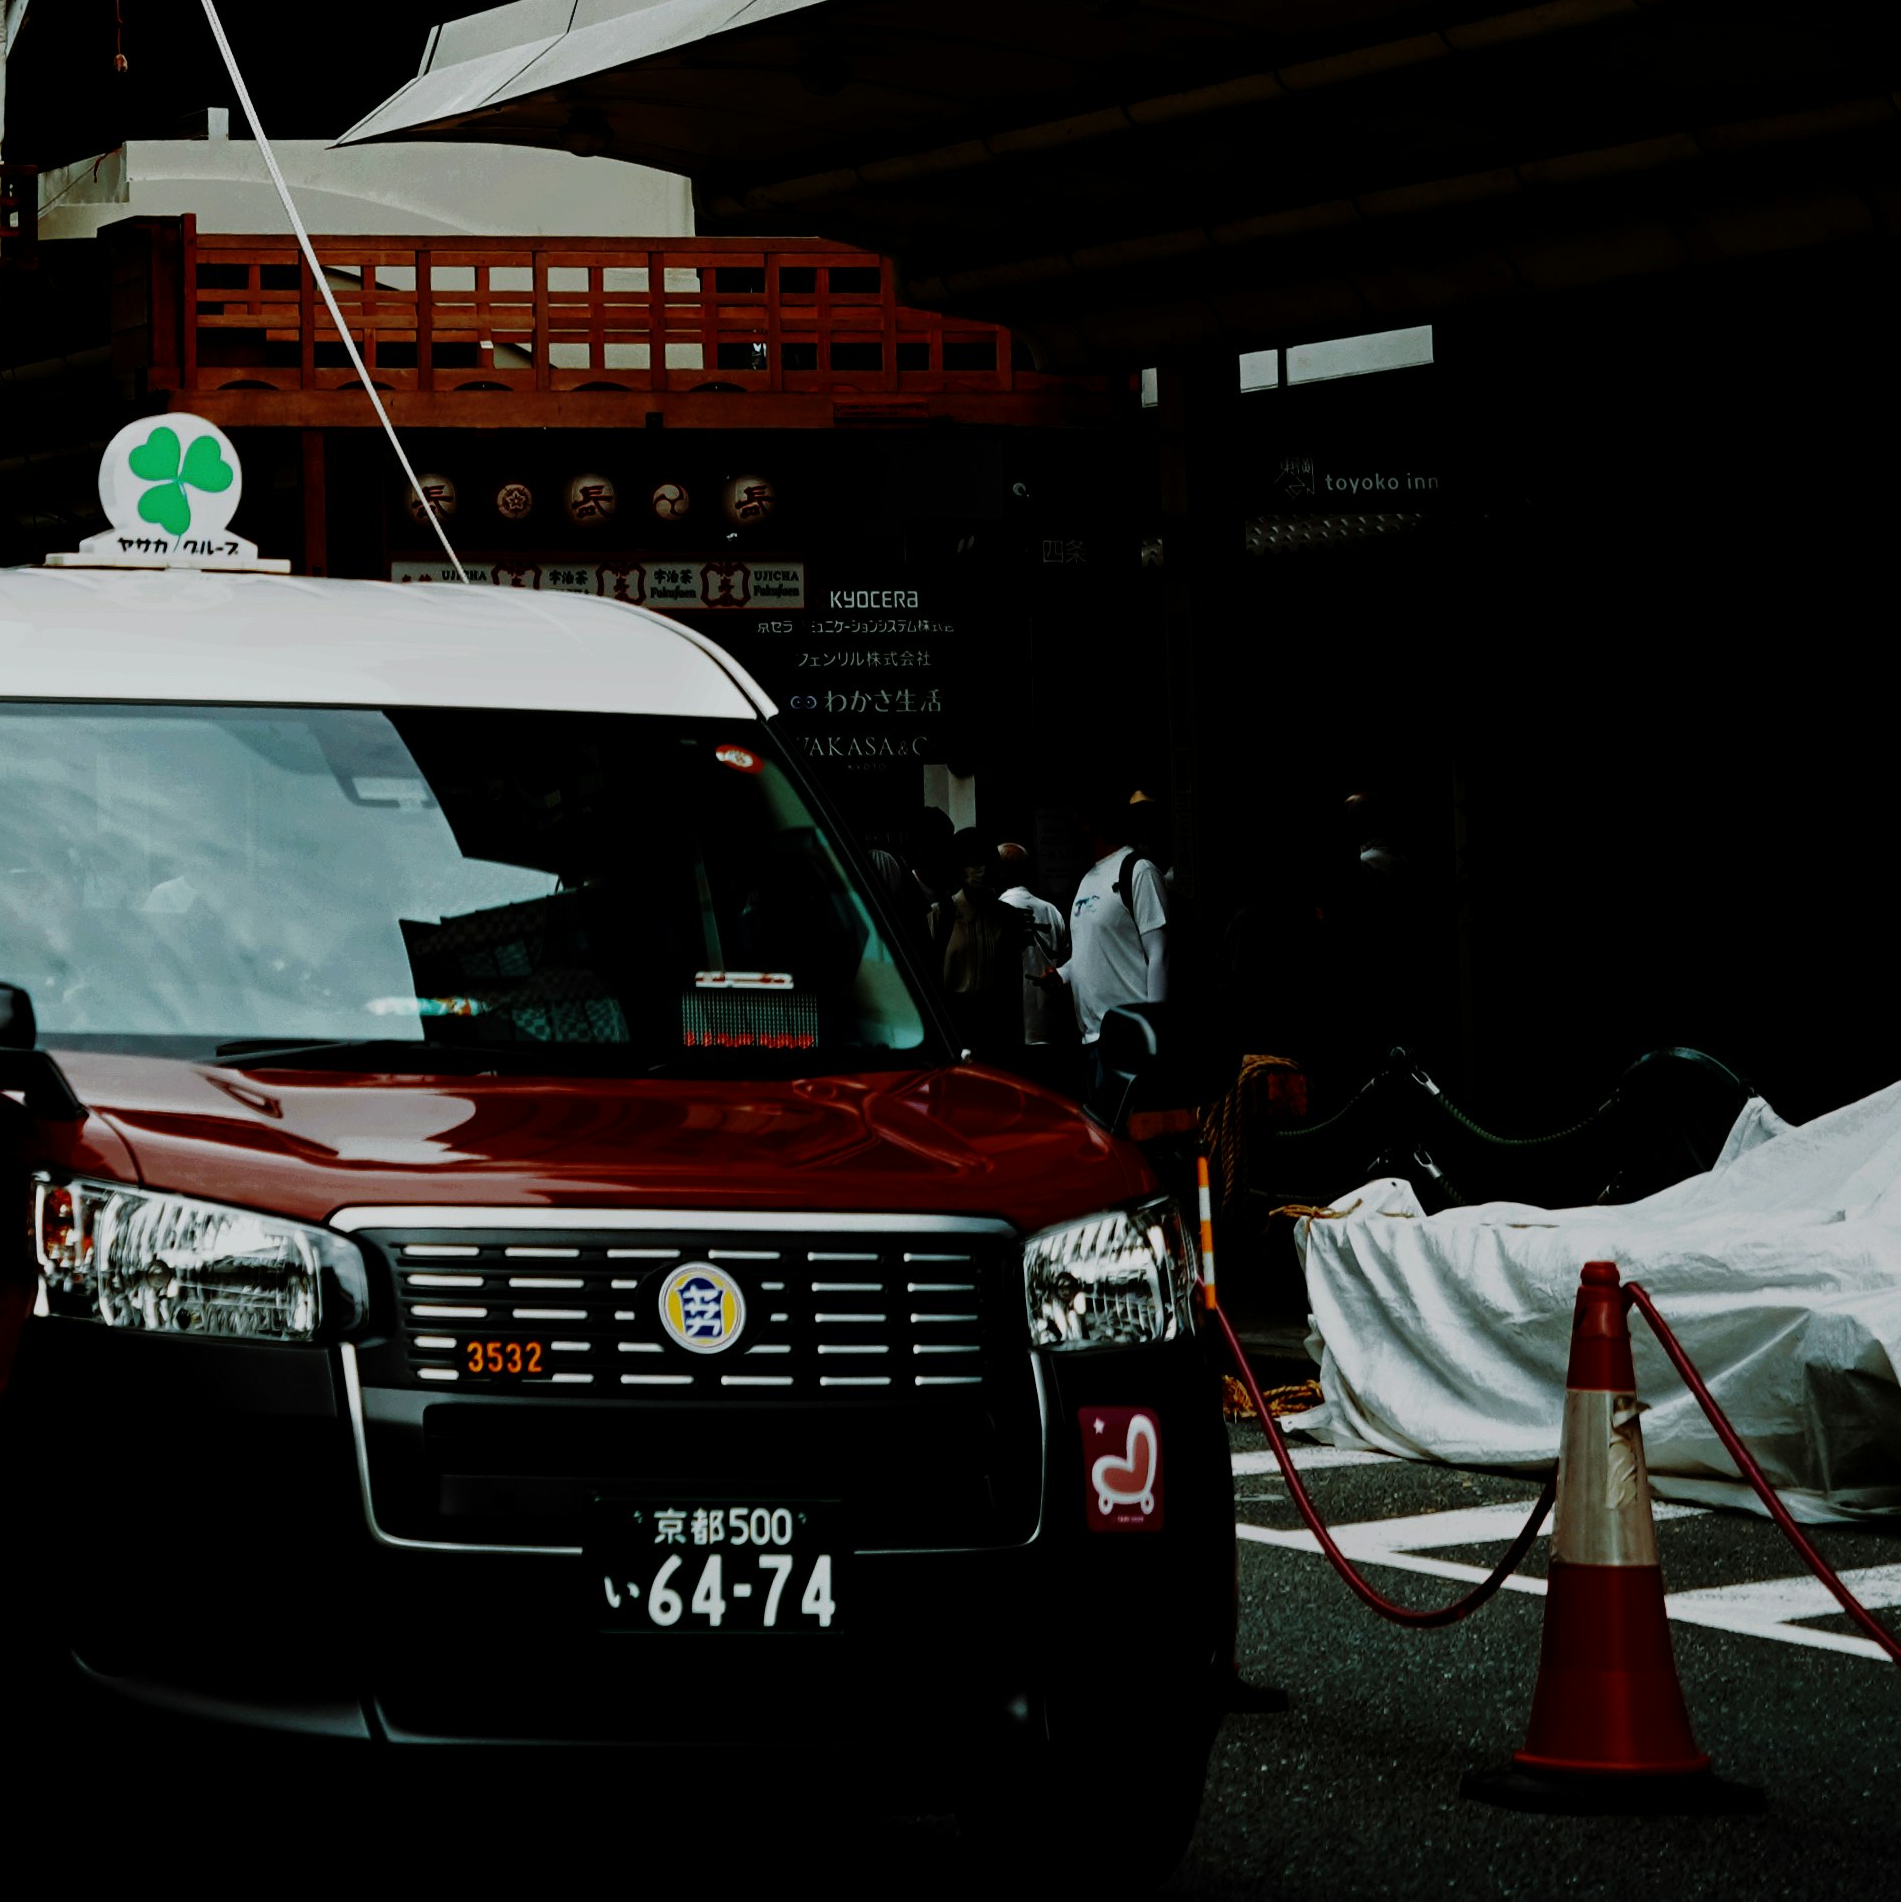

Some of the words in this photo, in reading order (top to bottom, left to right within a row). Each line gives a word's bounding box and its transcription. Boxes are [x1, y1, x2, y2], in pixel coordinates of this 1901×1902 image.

[1324, 473, 1401, 496] toyoko
[1406, 472, 1440, 491] inn
[117, 537, 168, 553] ヤサカ
[753, 570, 800, 581] UJICHA
[829, 590, 920, 609] KYOCERA
[824, 688, 943, 713] わかさ生活
[465, 1340, 545, 1374] 3532
[653, 1505, 795, 1547] 京都500
[602, 1574, 641, 1610] い
[646, 1552, 838, 1628] 64-74
